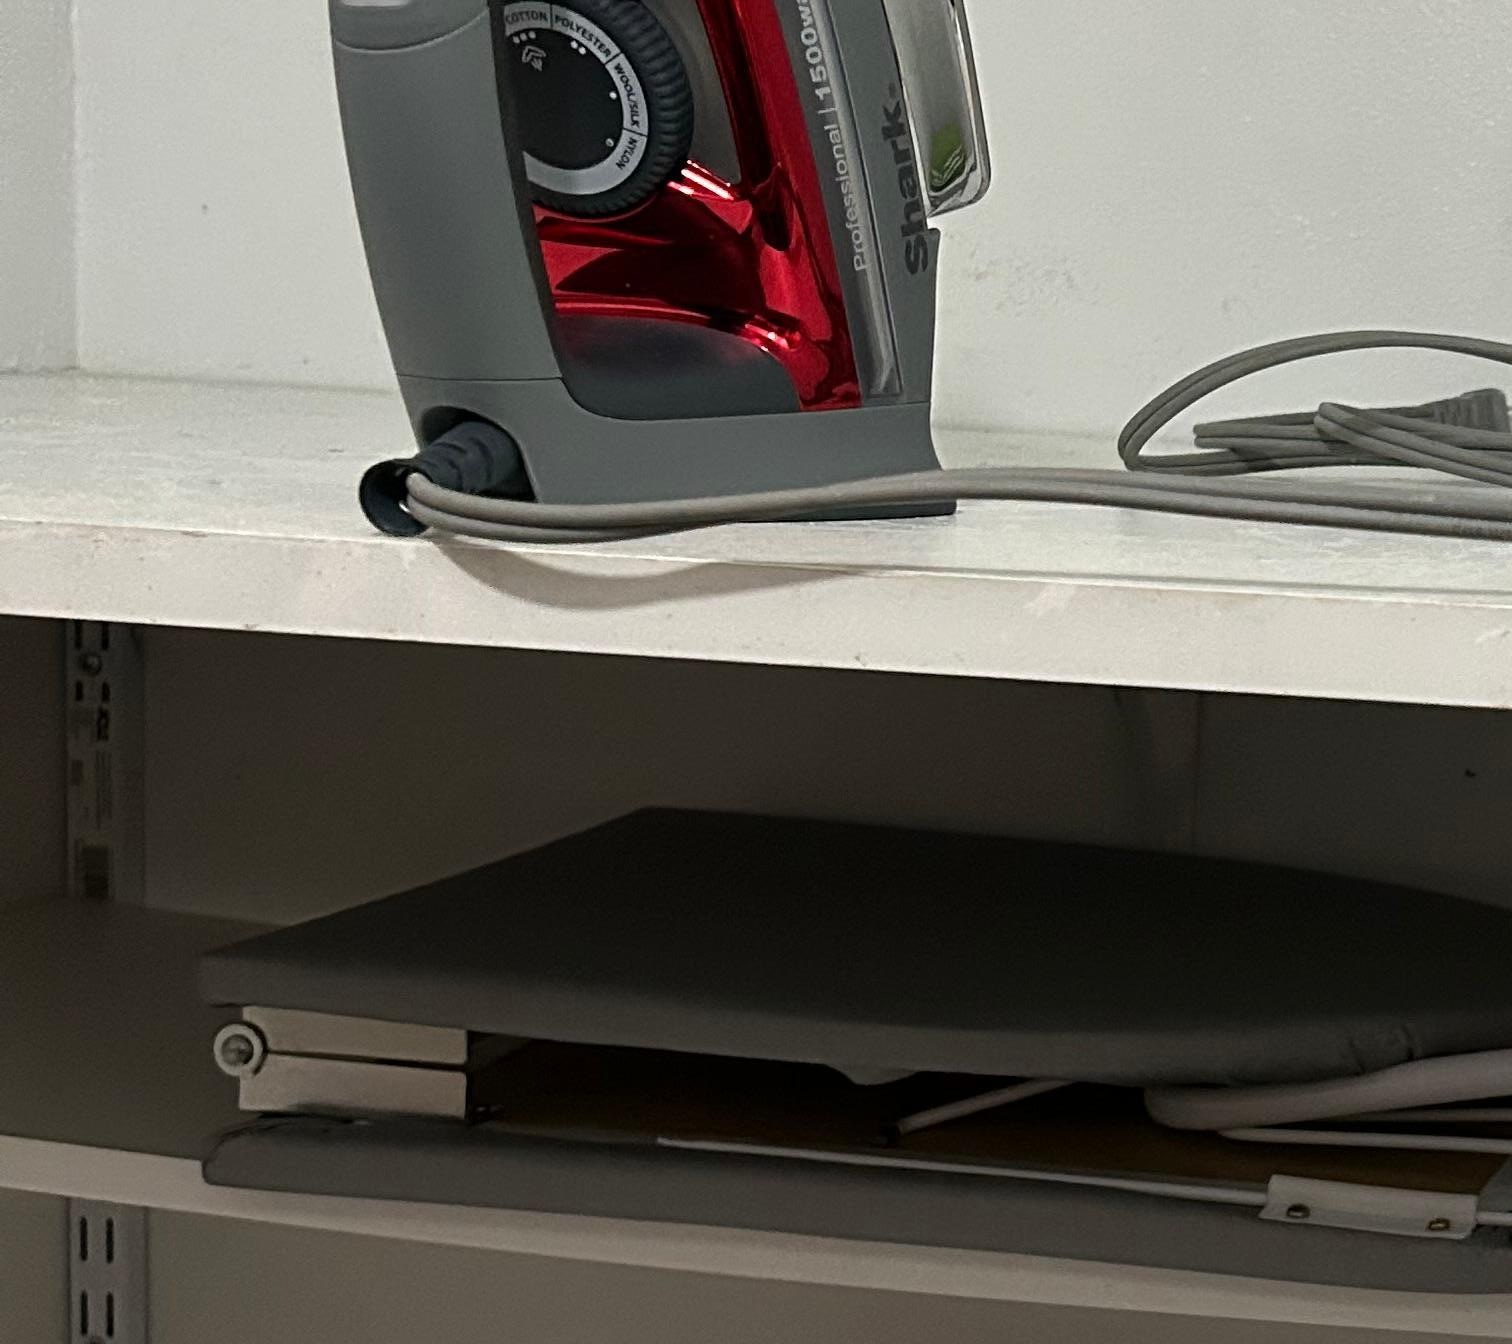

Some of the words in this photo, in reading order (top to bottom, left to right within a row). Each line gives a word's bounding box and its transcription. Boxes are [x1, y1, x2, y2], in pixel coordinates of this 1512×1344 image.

[505, 10, 548, 25] COTTON
[555, 14, 613, 58] POLYESTER
[614, 62, 641, 130] WOOL/SILK
[615, 137, 639, 170] NYLON
[823, 125, 867, 272] Professional
[881, 101, 929, 276] Shark
